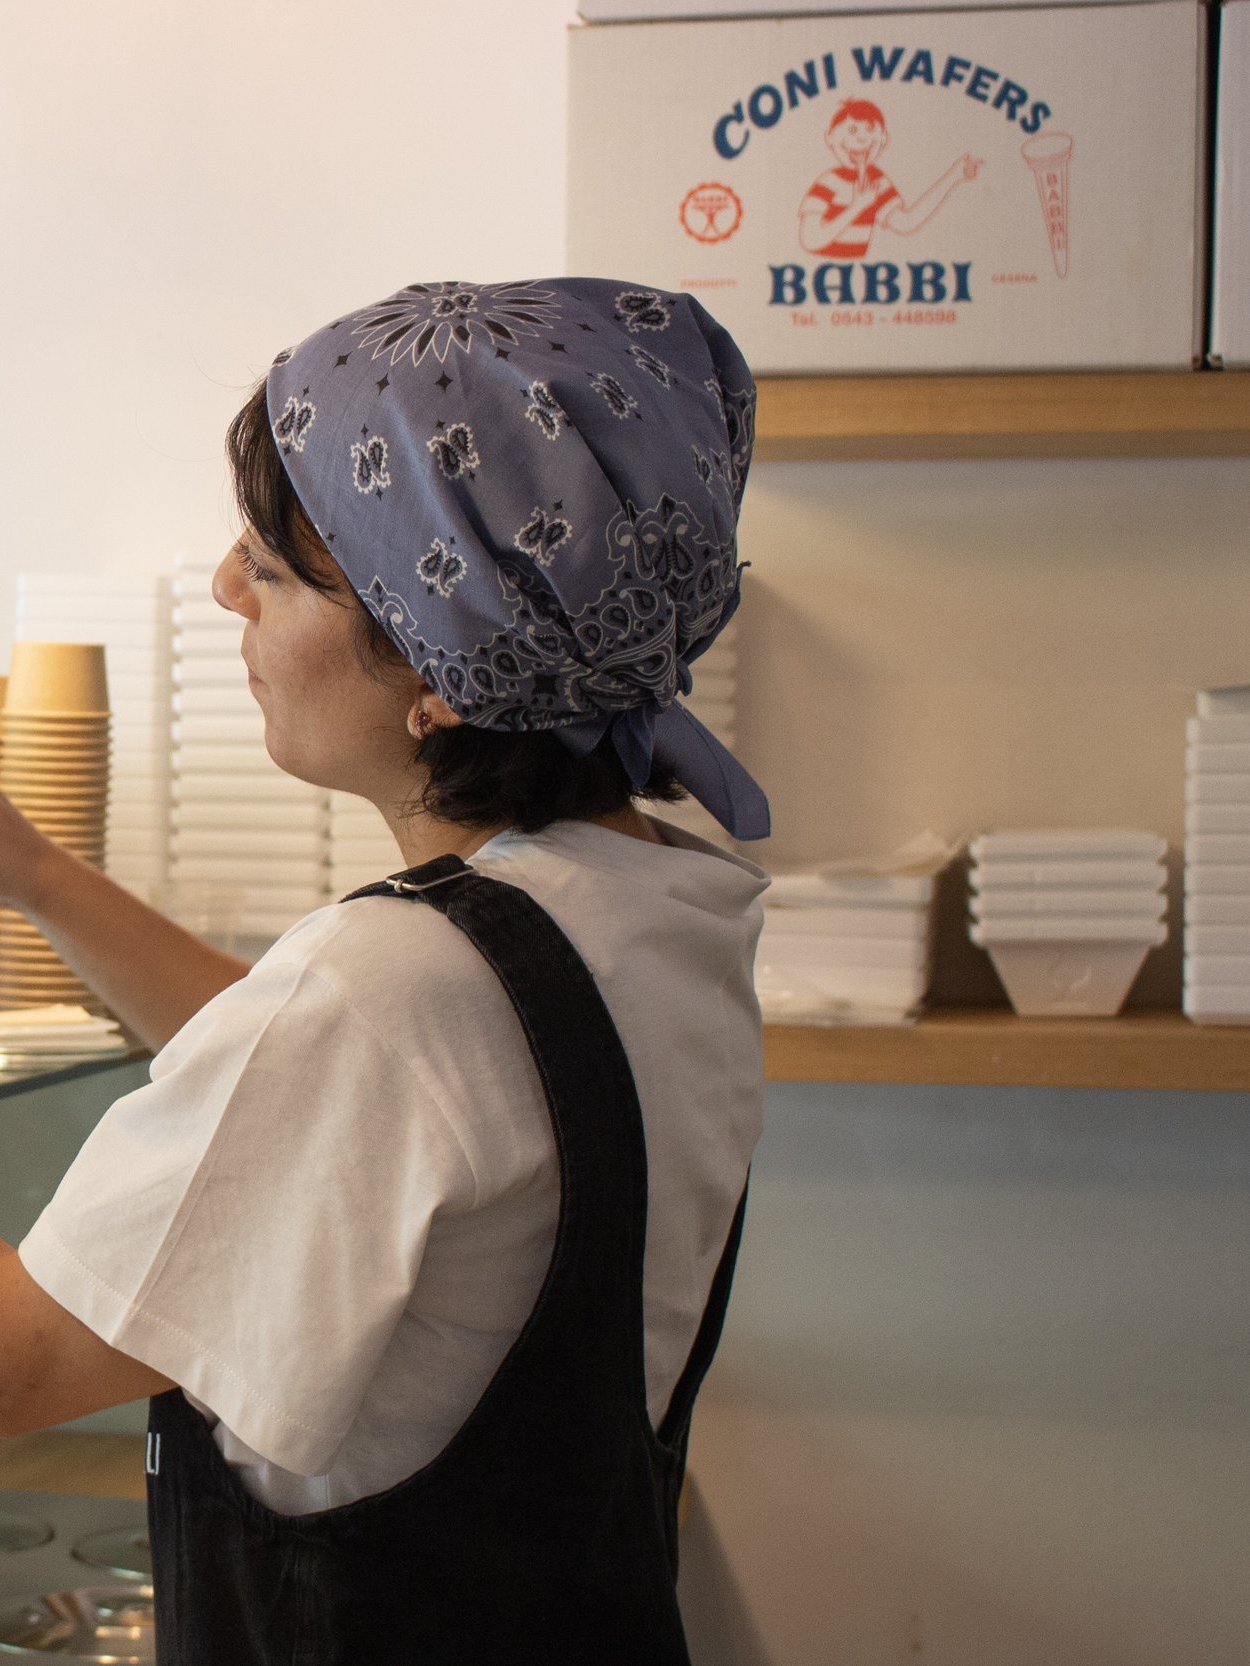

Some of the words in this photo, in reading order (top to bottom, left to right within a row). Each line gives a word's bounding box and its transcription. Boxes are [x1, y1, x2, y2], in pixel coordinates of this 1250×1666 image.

[713, 54, 837, 160] CONI
[852, 46, 1052, 135] WAFERS
[768, 262, 973, 306] BABBI
